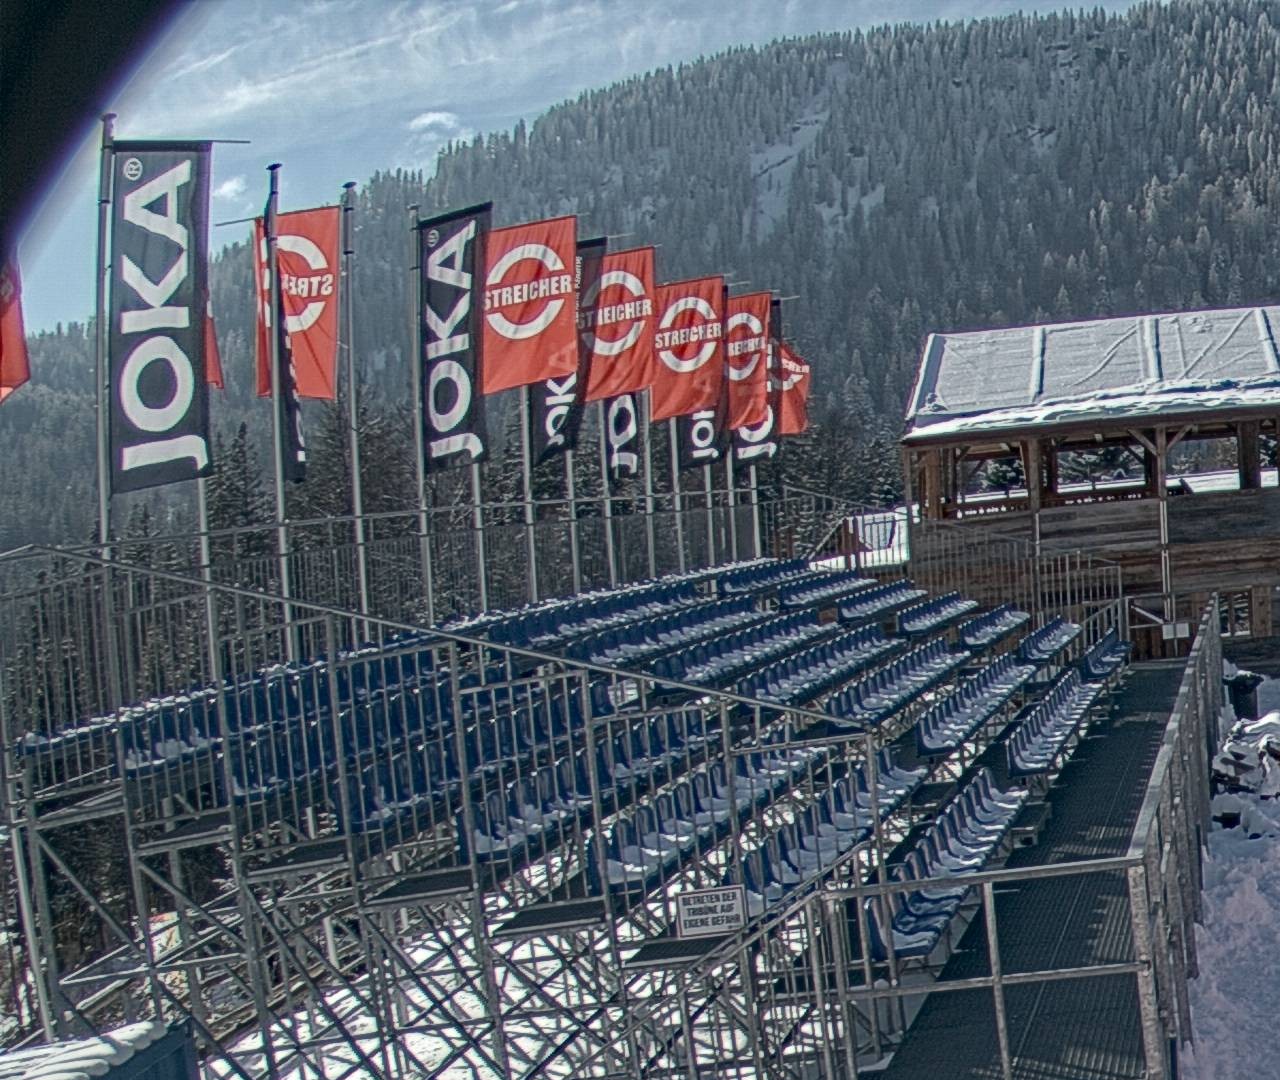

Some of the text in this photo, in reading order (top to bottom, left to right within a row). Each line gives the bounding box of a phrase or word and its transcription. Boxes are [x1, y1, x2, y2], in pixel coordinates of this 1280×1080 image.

[120, 159, 209, 471] JOKA
[426, 219, 484, 459] JOKA
[484, 274, 573, 311] STREICHER
[655, 322, 722, 349] STREICHER
